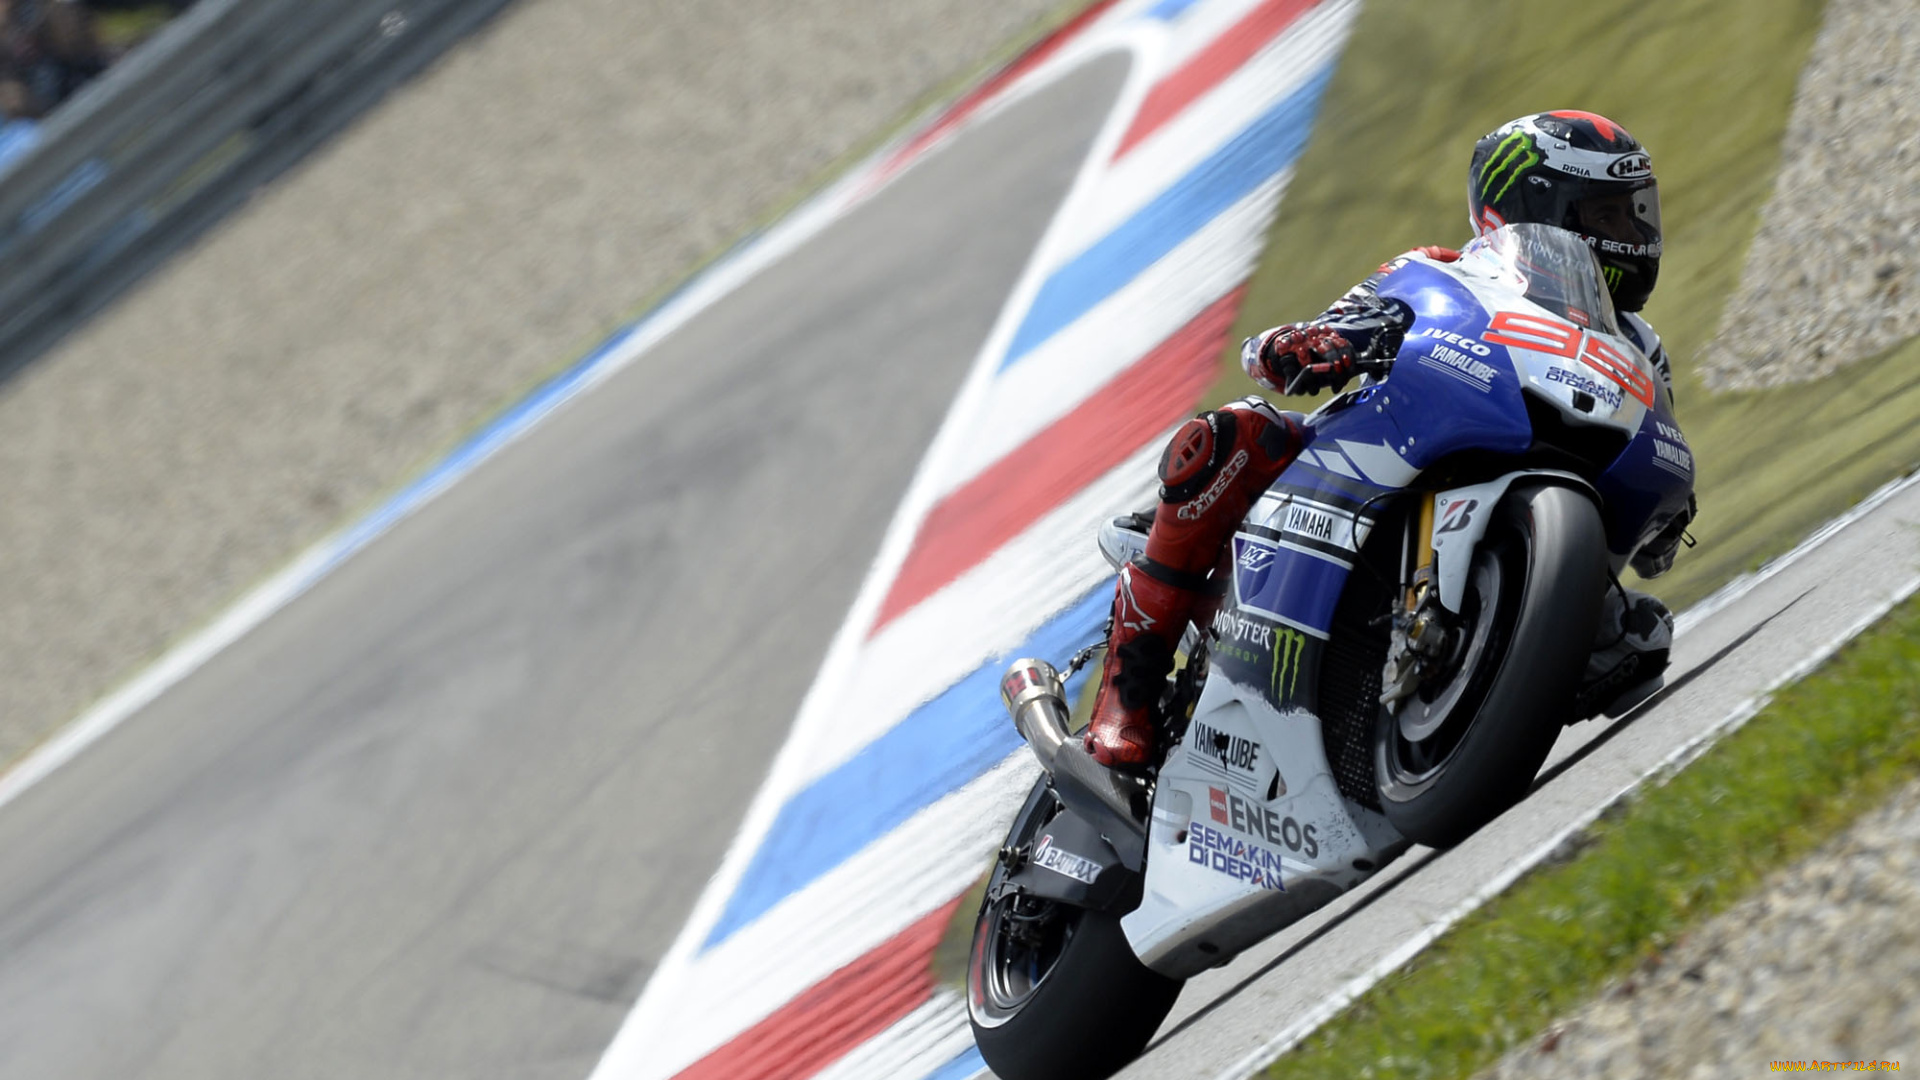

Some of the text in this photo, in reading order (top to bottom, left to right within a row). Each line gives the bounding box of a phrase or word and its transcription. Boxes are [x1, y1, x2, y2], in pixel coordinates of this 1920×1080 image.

[1562, 164, 1591, 177] RPHA
[1601, 240, 1647, 256] SECTOR
[1422, 327, 1491, 357] IVECO
[1429, 343, 1499, 384] YAMALUBE
[1480, 310, 1654, 412] 99
[1656, 421, 1688, 446] IVEC
[1653, 438, 1691, 471] YAMALUBE
[1288, 506, 1333, 541] YAMAHA
[1211, 608, 1271, 651] MONSTER
[1215, 640, 1260, 665] ENERGY
[1229, 794, 1319, 860] ENEOS
[1045, 849, 1099, 882] BATTLAX
[1212, 852, 1287, 893] DEPAN
